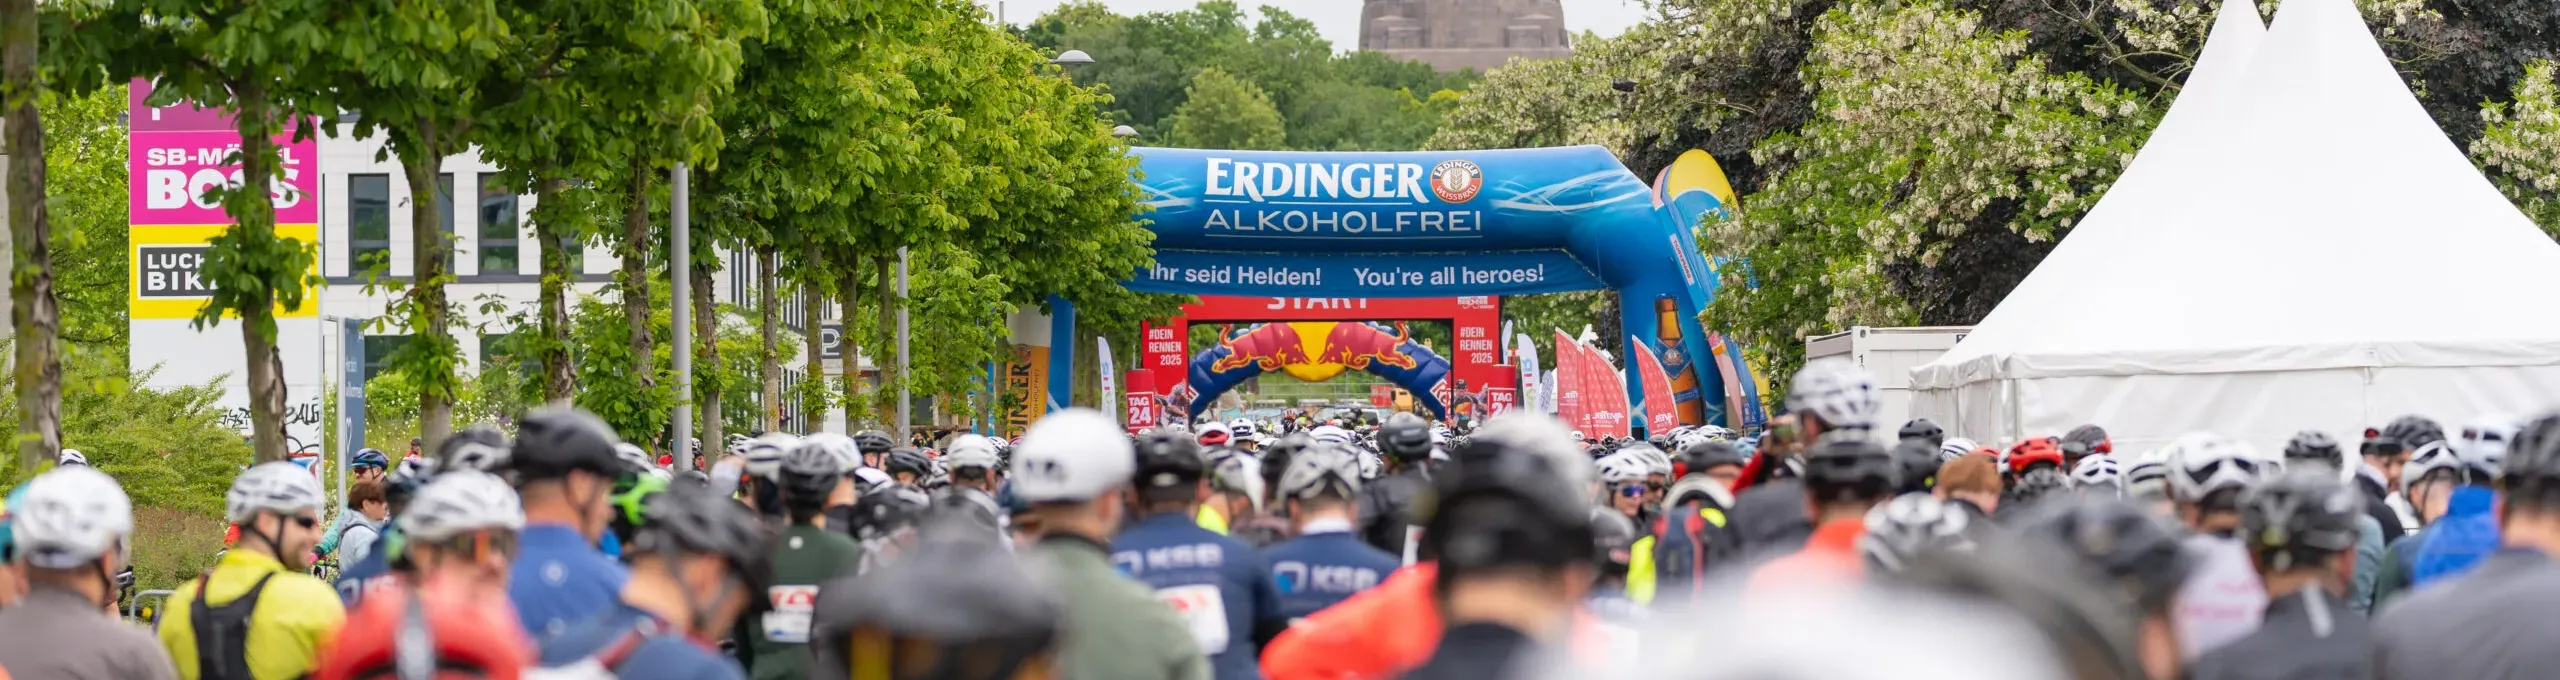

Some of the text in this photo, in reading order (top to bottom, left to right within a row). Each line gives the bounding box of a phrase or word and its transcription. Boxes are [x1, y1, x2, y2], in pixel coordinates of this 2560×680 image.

[147, 143, 300, 166] SB-MÖL
[1433, 161, 1480, 177] ERDINGER
[1204, 157, 1430, 203] ERDINGER
[1203, 208, 1481, 233] ALKOHOLFREI
[147, 271, 218, 291] BIK
[1150, 263, 1321, 286] Ihr seid Helden!
[1353, 263, 1544, 286] You're all heroes!
[1148, 328, 1173, 340] #DEIN
[1460, 326, 1484, 338] #DEIN
[1148, 341, 1182, 353] RENNEN
[1460, 339, 1493, 351] RENNEN
[1160, 354, 1182, 366] 2025
[1471, 352, 1493, 364] 2025
[1128, 396, 1150, 406] TAG
[1491, 392, 1513, 402] TAG
[1129, 406, 1152, 425] 24
